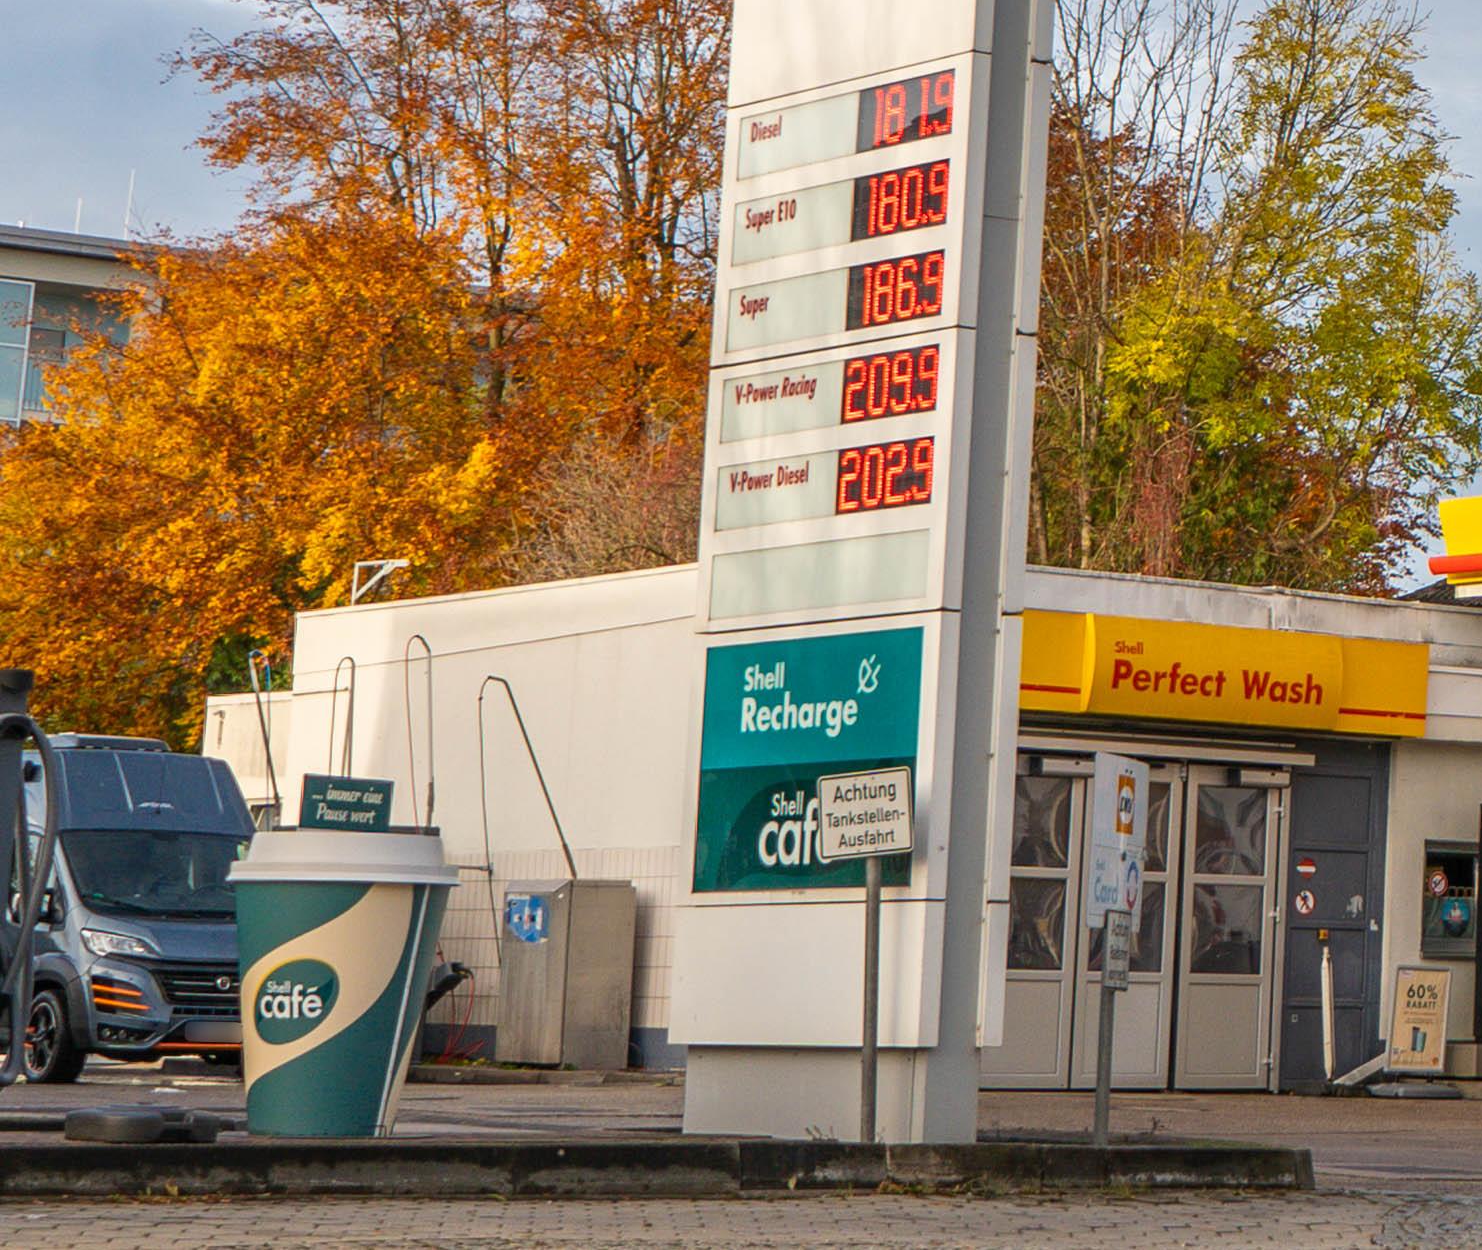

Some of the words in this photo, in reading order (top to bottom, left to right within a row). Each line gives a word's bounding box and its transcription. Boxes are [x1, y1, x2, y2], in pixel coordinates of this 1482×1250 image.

[750, 115, 782, 143] Diesel
[745, 208, 773, 233] Super
[777, 198, 797, 223] E10
[867, 161, 949, 236] 180.9
[739, 295, 769, 320] Super
[861, 252, 945, 327] 186.9
[735, 381, 778, 406] V-Power
[781, 374, 817, 400] Racing
[844, 347, 939, 422] 209.9
[730, 470, 773, 494] V-Power
[777, 461, 810, 487] Diesel
[838, 438, 935, 512] 202.9
[1114, 640, 1144, 656] Shell
[743, 661, 786, 693] Shell
[1111, 658, 1226, 698] Perfect
[1243, 669, 1324, 706] Wash
[740, 691, 858, 738] Recharge
[770, 790, 806, 817] Shell
[833, 782, 897, 804] Achtung
[316, 802, 350, 821] Pause
[826, 807, 906, 828] Tankstellen-
[757, 797, 834, 868] caf
[838, 828, 896, 849] Ausfahrt
[1094, 873, 1119, 904] Card
[260, 983, 323, 1019] café
[1406, 983, 1439, 1000] 60%
[1406, 1000, 1437, 1009] RABATT
